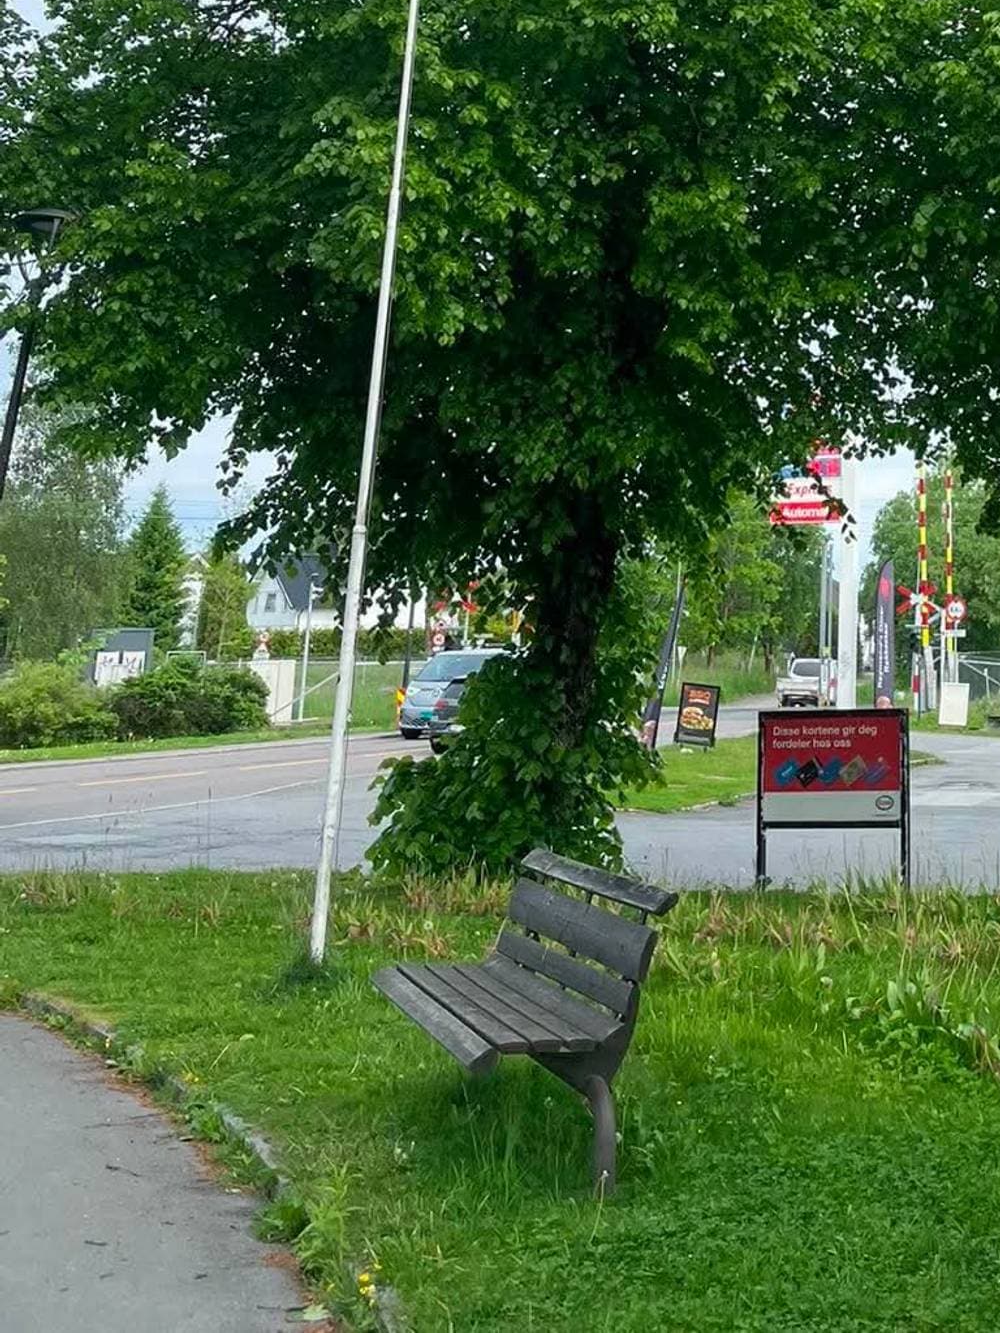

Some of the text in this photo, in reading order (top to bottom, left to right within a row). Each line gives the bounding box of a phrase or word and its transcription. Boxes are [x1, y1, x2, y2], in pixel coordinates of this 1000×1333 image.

[788, 483, 833, 497] Exprs
[773, 725, 878, 737] Disse kortene gir deg
[772, 739, 851, 749] fordeler hos oss
